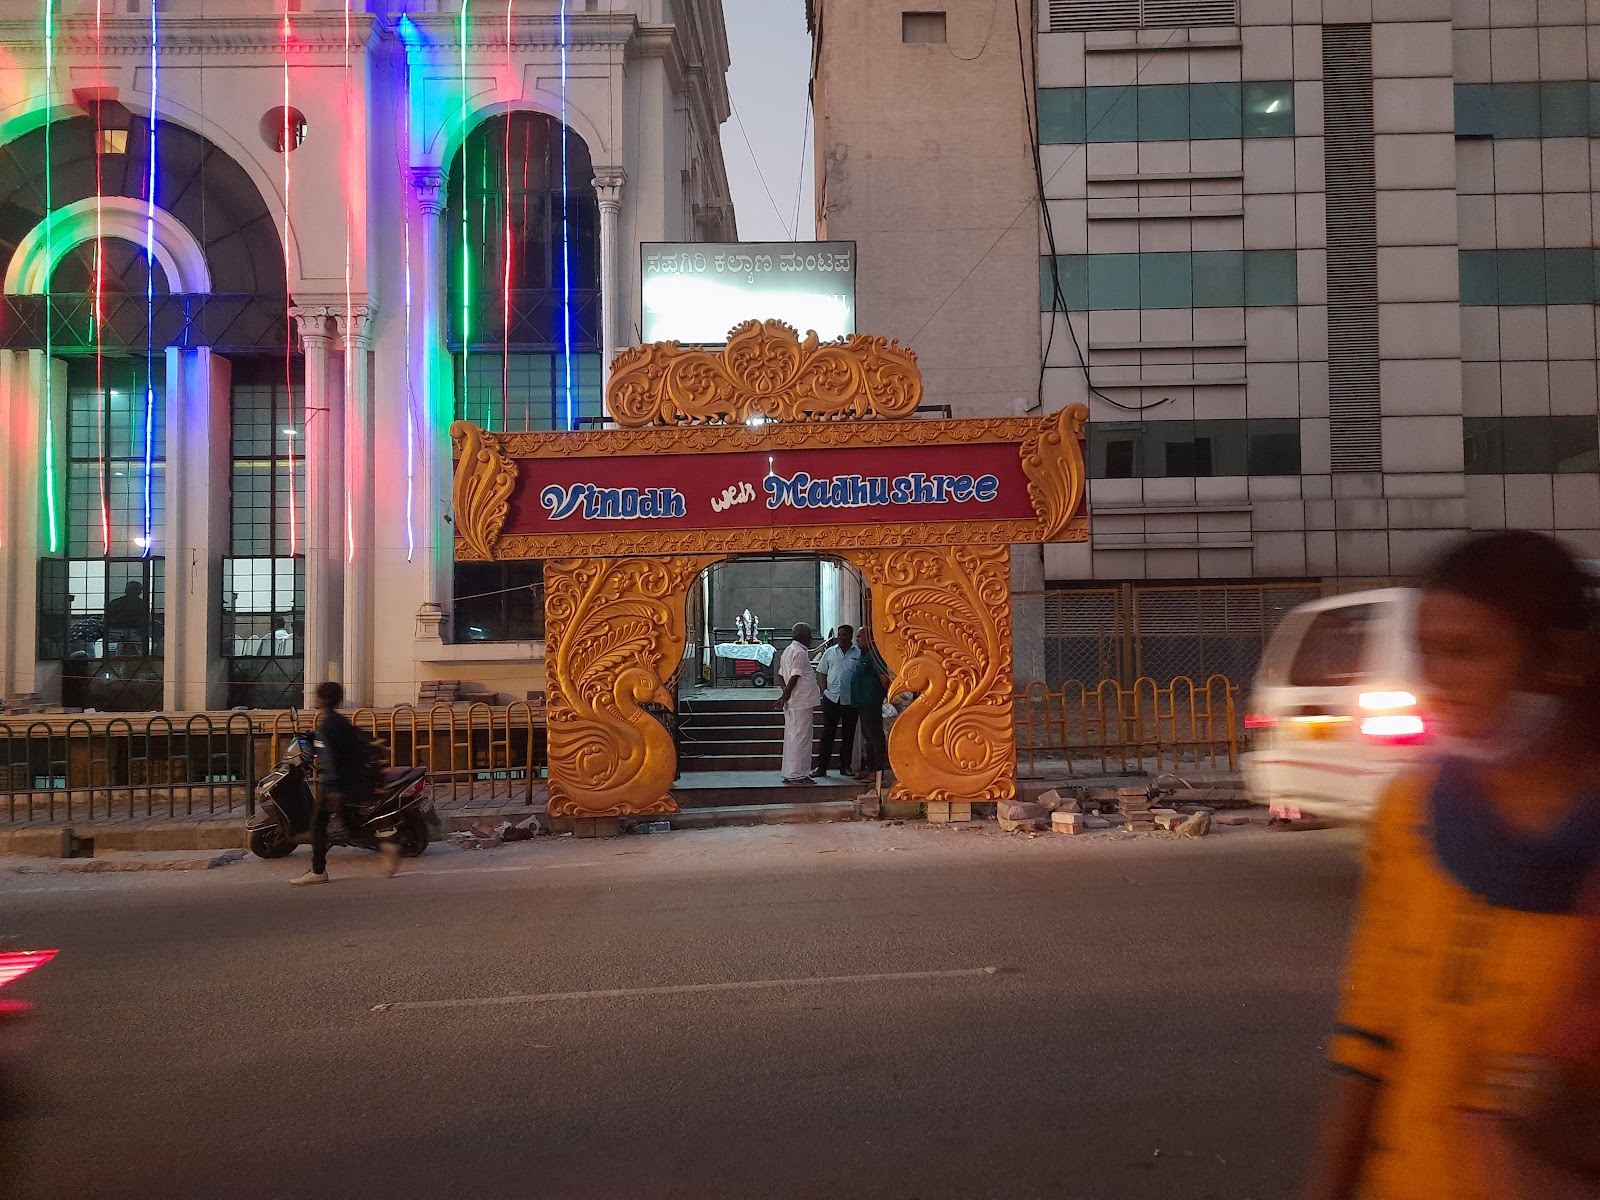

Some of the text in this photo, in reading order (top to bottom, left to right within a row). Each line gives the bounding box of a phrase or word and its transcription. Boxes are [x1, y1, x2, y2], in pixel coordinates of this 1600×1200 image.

[714, 250, 773, 284] ಕಲ್ಯಾಣ
[779, 249, 851, 273] ಮಂಟಪ
[540, 483, 687, 520] Vinodh
[711, 481, 756, 512] weds
